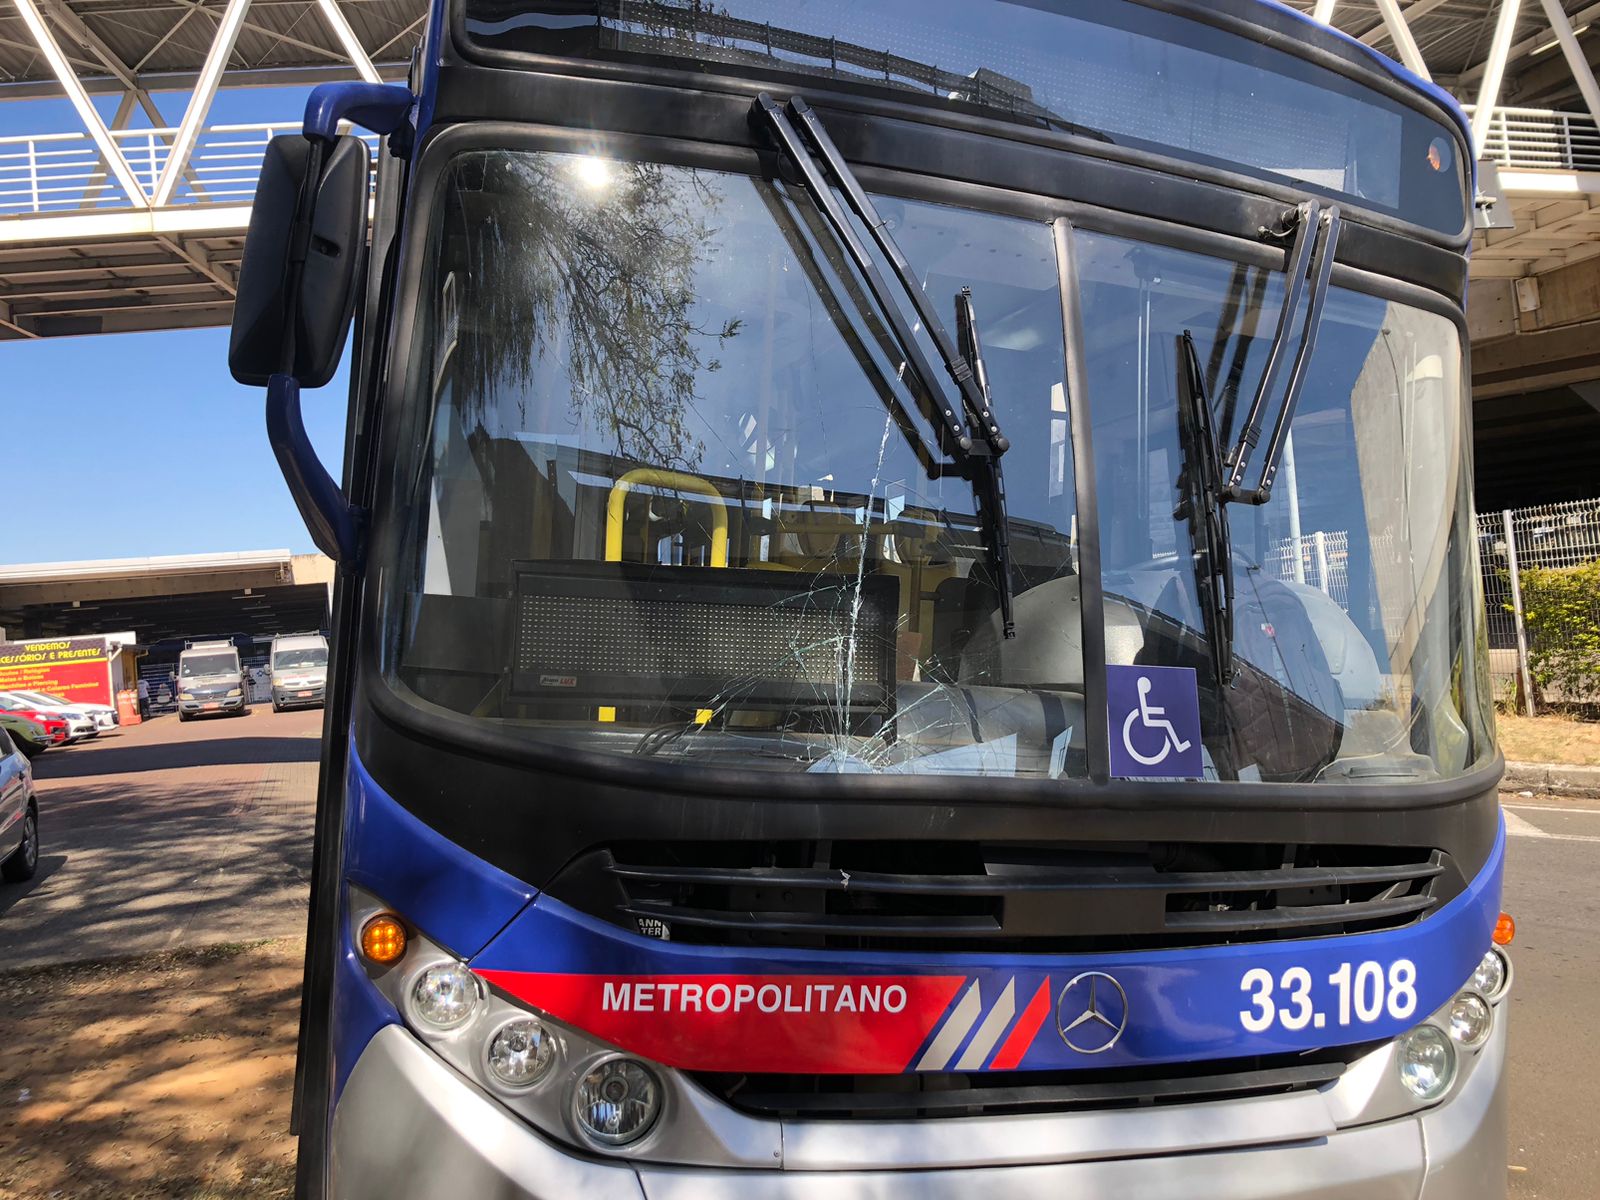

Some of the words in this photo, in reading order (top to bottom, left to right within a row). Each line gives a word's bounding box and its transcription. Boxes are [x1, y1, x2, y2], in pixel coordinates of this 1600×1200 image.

[0, 652, 46, 664] CESSÓRIOS
[49, 652, 55, 660] E
[58, 648, 101, 660] PRESENTES
[25, 641, 71, 652] VENDEMOS
[602, 982, 907, 1013] METROPOLITANO
[1239, 959, 1417, 1033] 33.108
